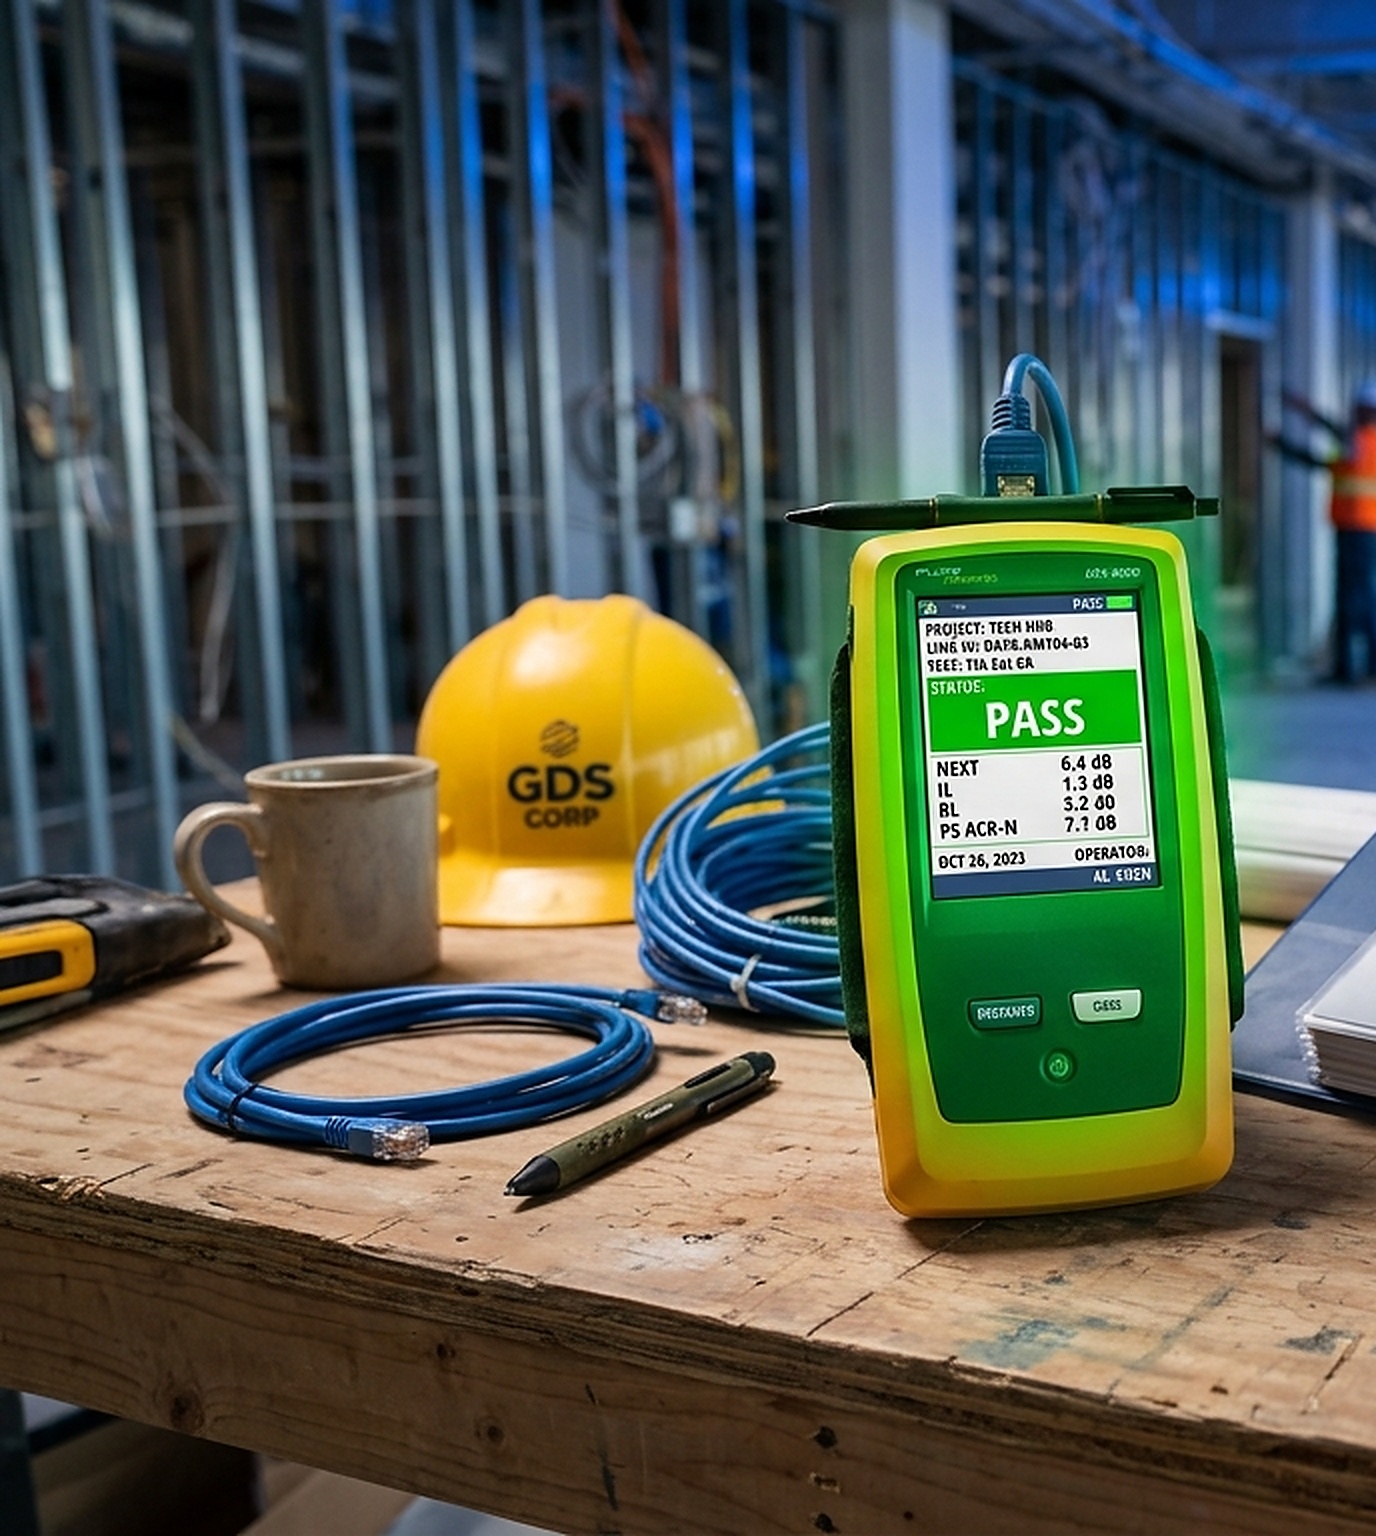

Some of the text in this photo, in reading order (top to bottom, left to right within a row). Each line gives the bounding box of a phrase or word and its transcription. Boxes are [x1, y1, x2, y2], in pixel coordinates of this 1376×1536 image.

[926, 621, 985, 639] PROJECT:
[985, 698, 1085, 739] PASS
[937, 760, 979, 777] NEXT
[1061, 756, 1086, 772] 6.4
[507, 763, 615, 803] GDS
[937, 782, 953, 798] IL
[1062, 776, 1087, 791] 1.3
[524, 806, 599, 829] CORP
[939, 802, 959, 818] BL
[940, 823, 960, 839] PS
[965, 819, 1018, 837] ACR-N
[993, 851, 1026, 866] 2023
